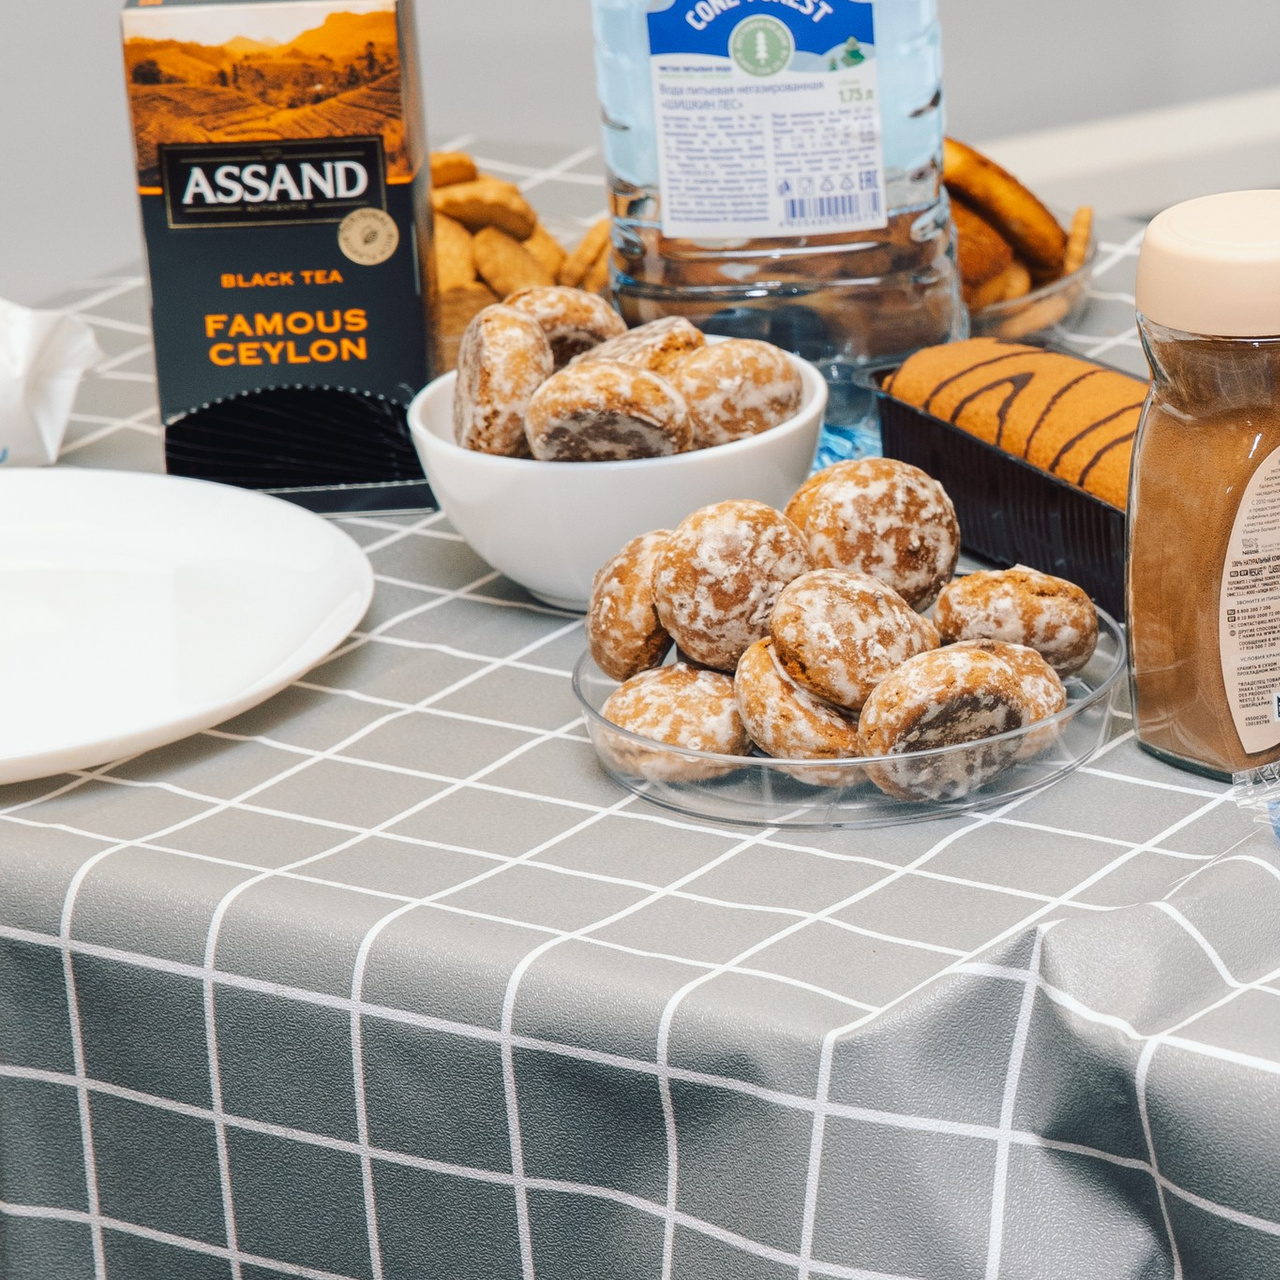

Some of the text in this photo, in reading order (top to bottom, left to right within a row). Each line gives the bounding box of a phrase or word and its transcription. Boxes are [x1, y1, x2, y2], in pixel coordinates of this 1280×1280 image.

[181, 160, 369, 205] ASSAND
[220, 269, 344, 289] BLACK TEA
[204, 308, 369, 338] FAMOUS
[208, 336, 369, 367] CEYLON
[1236, 597, 1260, 606] ЗВОНИТЕ
[1237, 627, 1255, 635] ДРУГИЕ
[1240, 654, 1265, 662] УСЛОВИЯ
[1236, 667, 1269, 677] ПРОХЛАДНОМ
